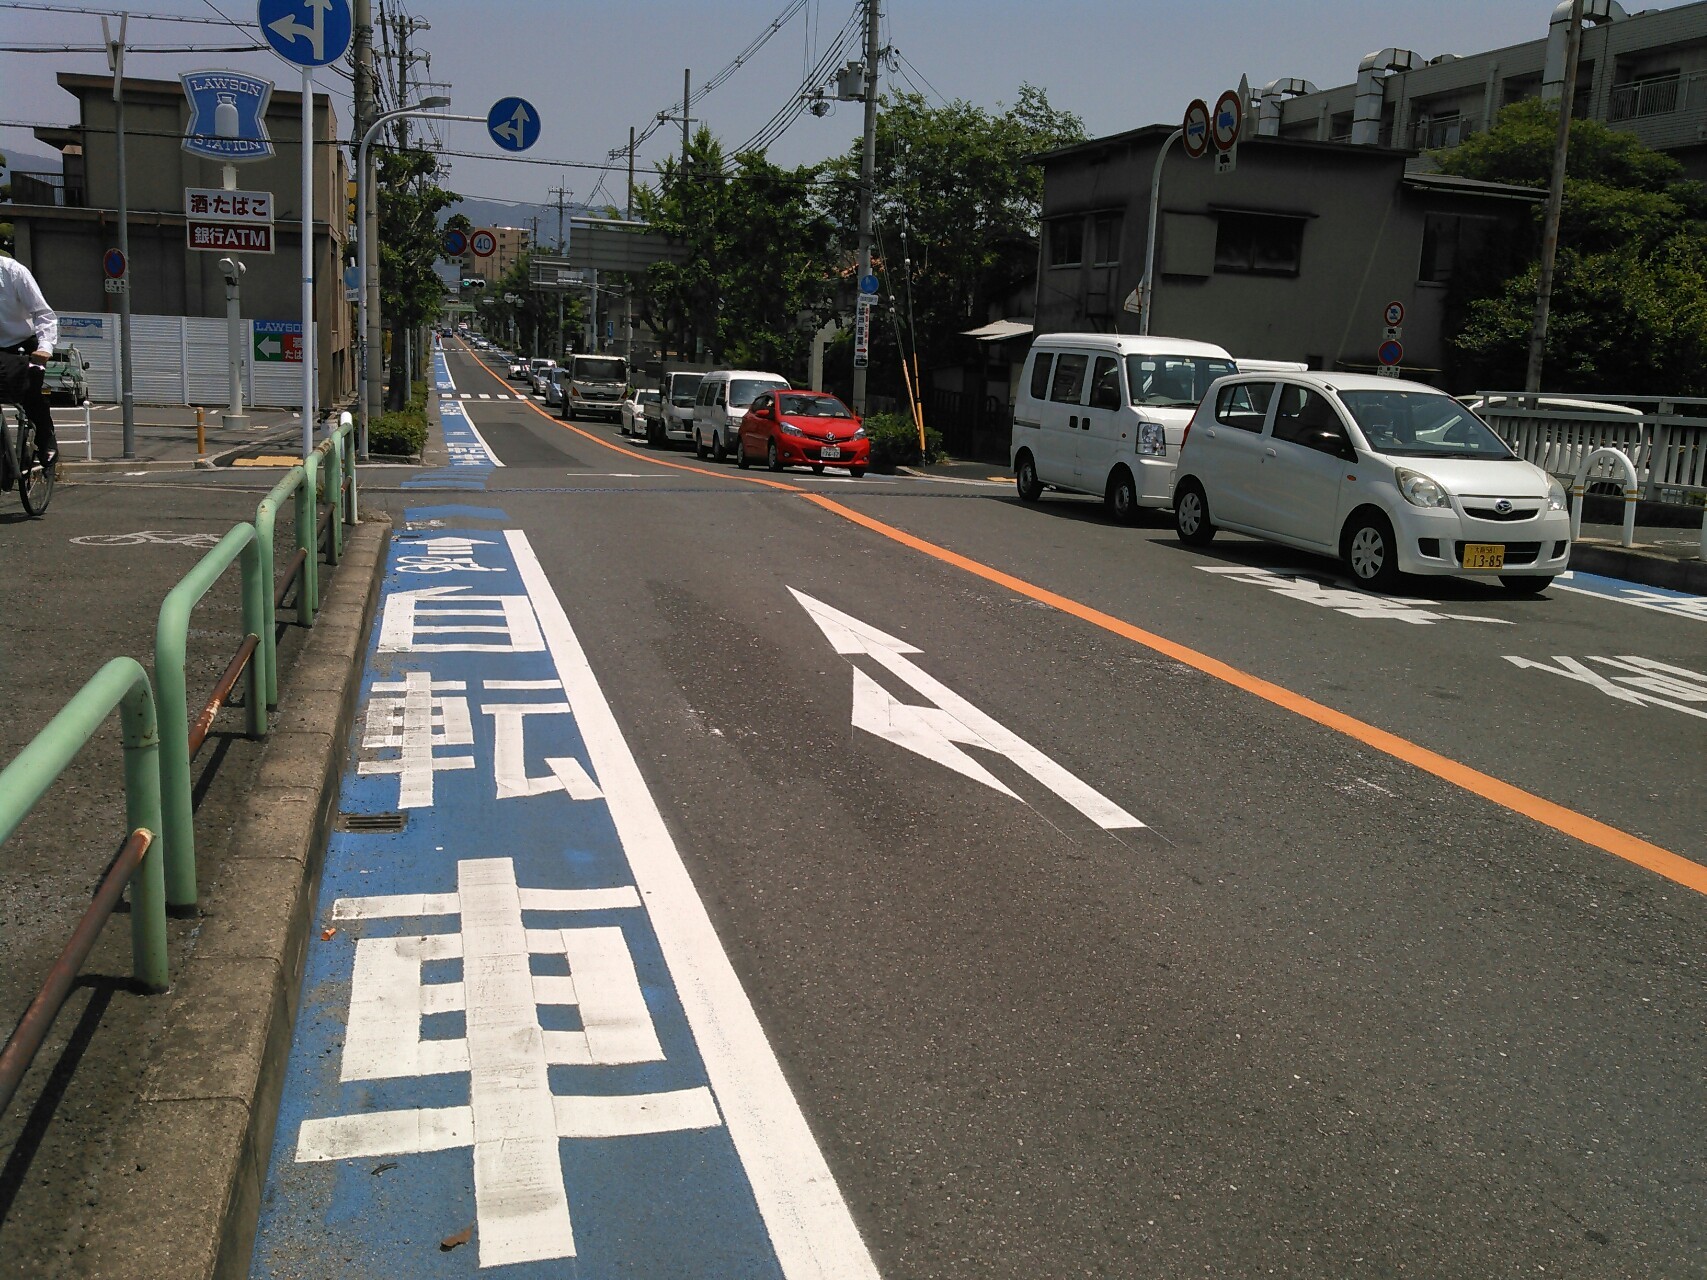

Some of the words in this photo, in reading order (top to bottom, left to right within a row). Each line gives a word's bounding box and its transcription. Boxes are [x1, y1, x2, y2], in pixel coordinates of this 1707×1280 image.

[191, 78, 262, 97] LAWSON
[193, 133, 261, 152] STATION
[194, 226, 266, 247] 銀行ATM
[476, 238, 491, 250] 40
[255, 322, 304, 333] LAWSO
[1473, 554, 1502, 567] 13-85
[295, 585, 722, 1268] 自転車
